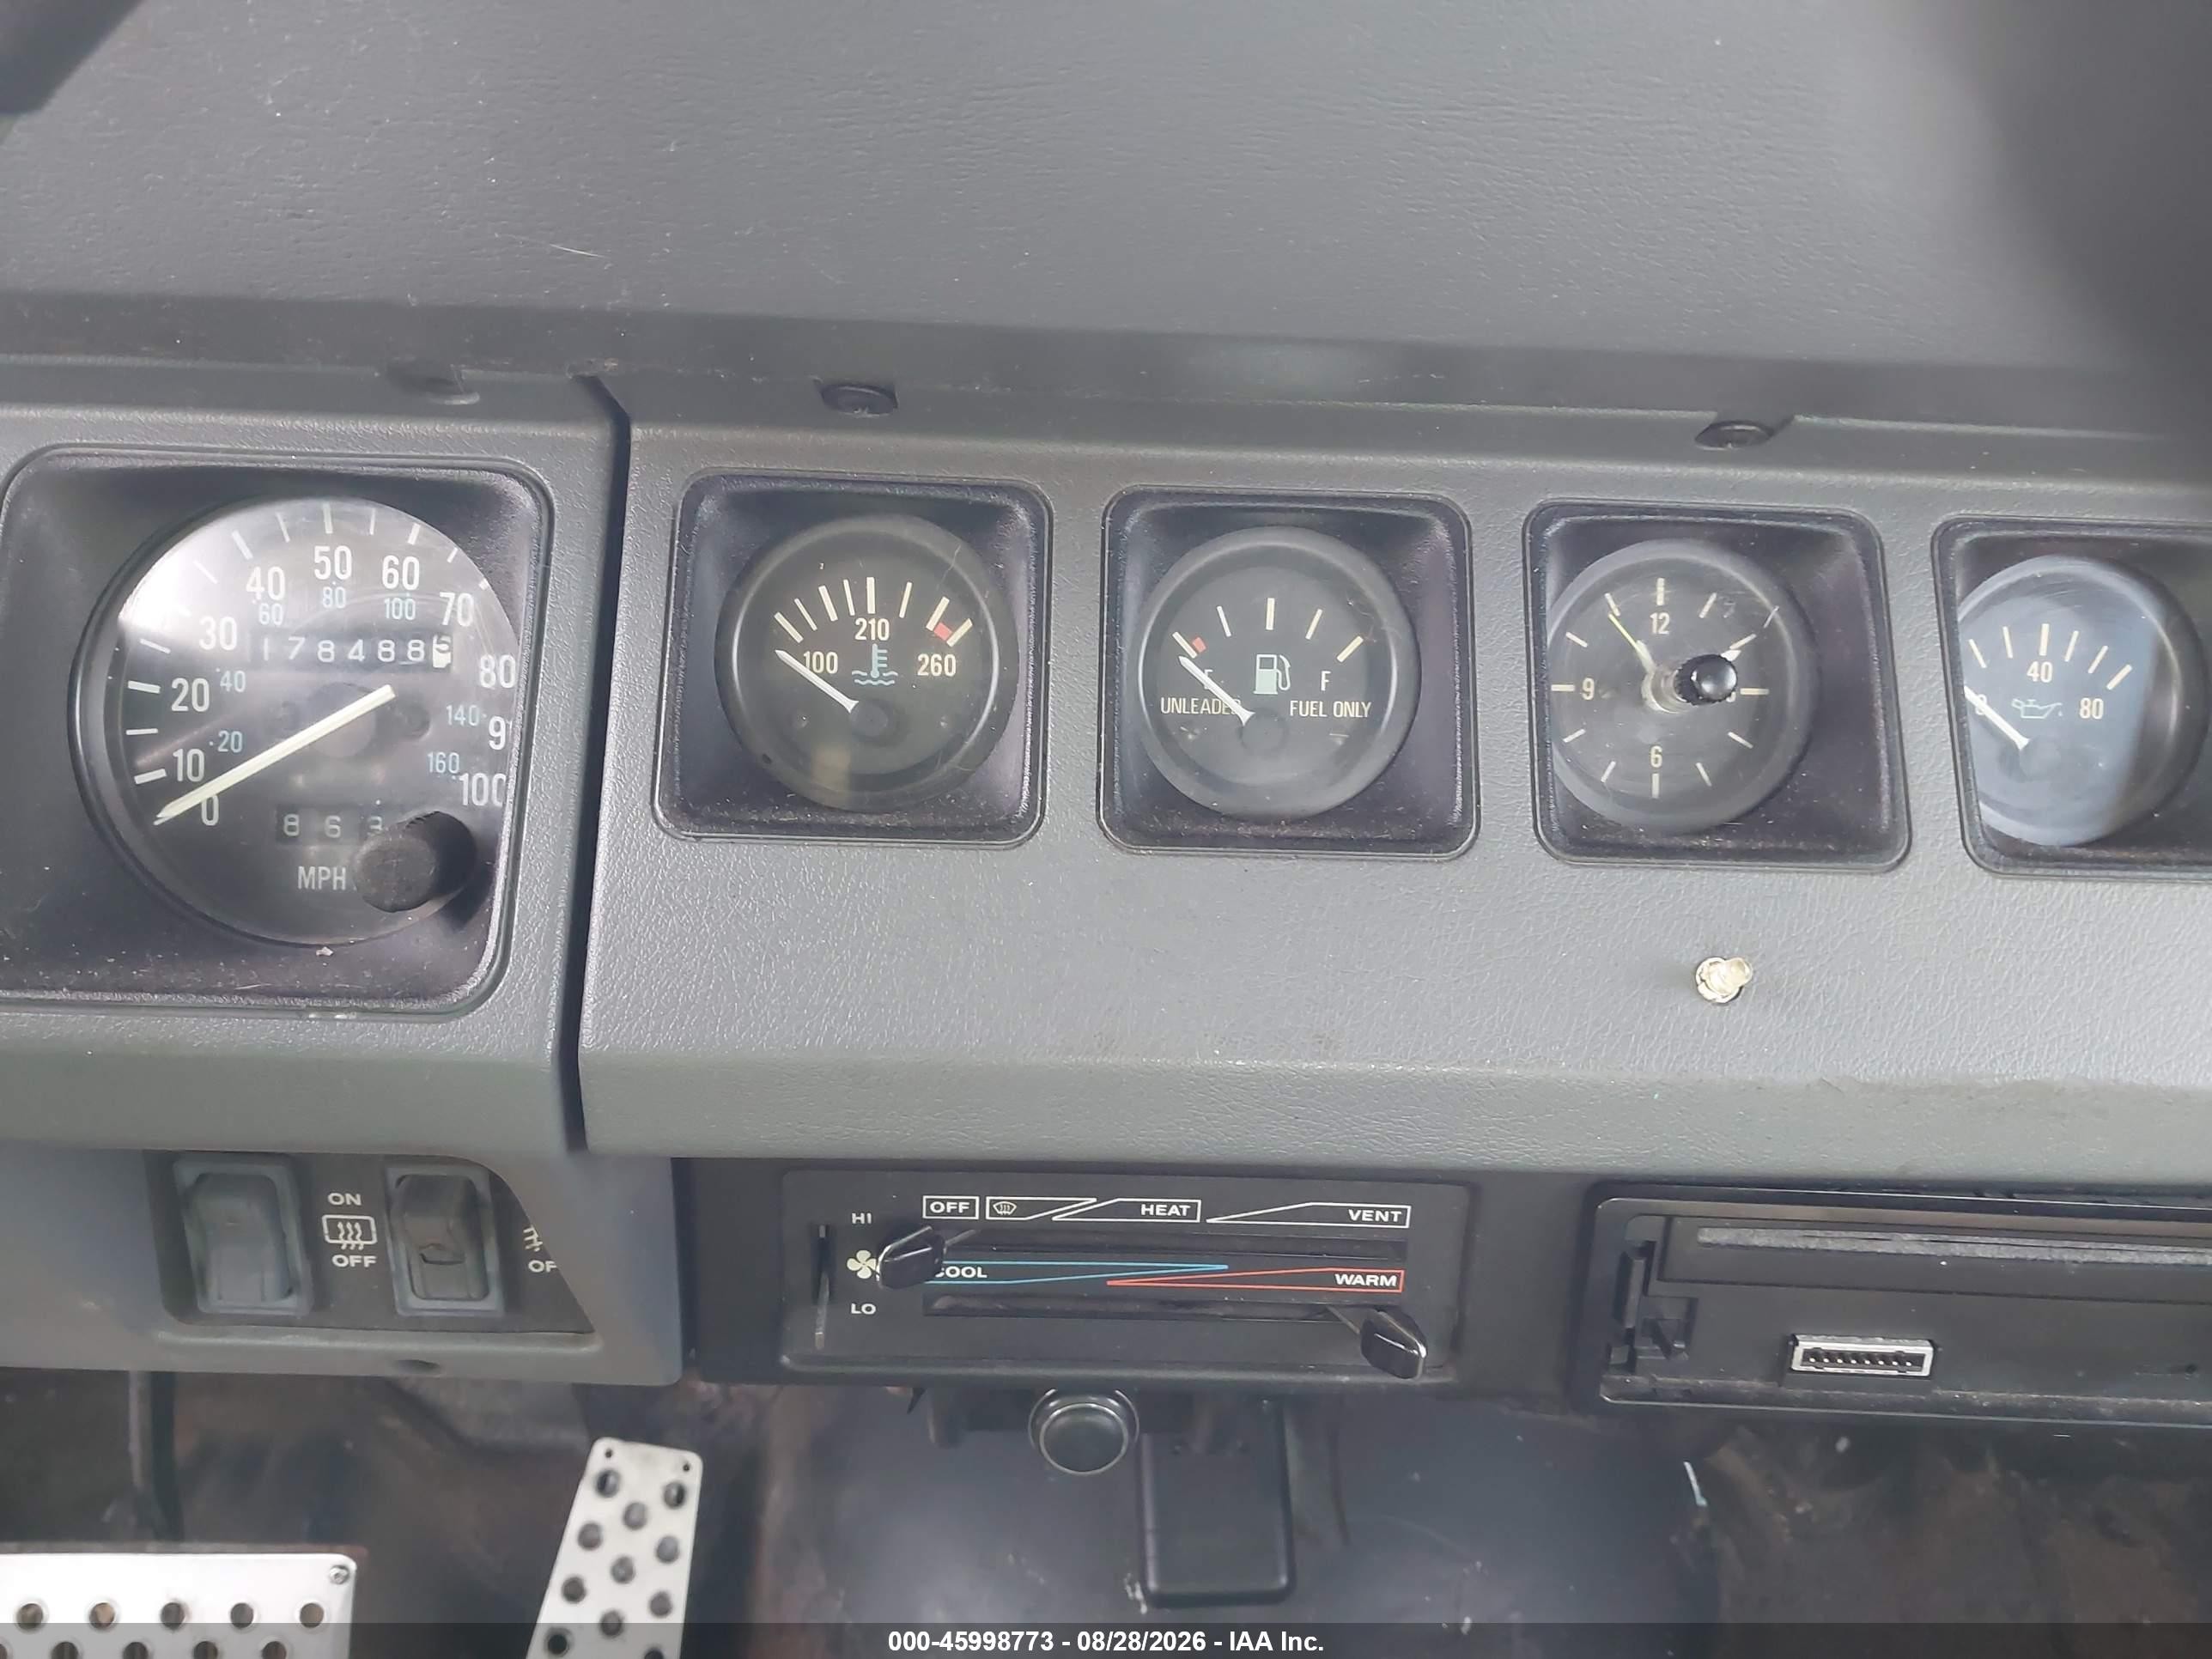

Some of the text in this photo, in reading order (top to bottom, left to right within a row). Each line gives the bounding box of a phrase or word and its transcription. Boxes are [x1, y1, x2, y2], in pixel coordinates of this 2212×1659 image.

[313, 545, 352, 580] 50
[381, 555, 420, 591] 60
[246, 565, 286, 601] 40
[322, 586, 347, 610] 80
[384, 597, 416, 621] 100
[439, 591, 475, 628] 70
[258, 602, 284, 626] 60
[1650, 612, 1670, 635] 12
[198, 615, 238, 651] 30
[854, 617, 890, 641] 210
[479, 653, 517, 690] 80
[803, 650, 839, 674] 100
[916, 653, 957, 678] 260
[2027, 660, 2053, 683] 40
[220, 670, 246, 693] 40
[1320, 671, 1331, 691] F
[1582, 678, 1595, 701] 9
[171, 677, 210, 713] 20
[446, 704, 481, 727] 140
[1289, 700, 1328, 718] FUEL
[1333, 701, 1372, 718] ONLY
[2079, 697, 2104, 720] 80
[217, 730, 244, 754] 20
[173, 748, 205, 783] 10
[427, 750, 460, 775] 160
[1650, 745, 1662, 768] 6
[201, 794, 220, 826] 0
[297, 866, 347, 890] MPH
[327, 1192, 362, 1206] ON
[929, 1201, 970, 1214] OFF
[1140, 1203, 1191, 1218] HEAT
[851, 1212, 872, 1224] HI
[1347, 1209, 1402, 1223] VENT
[331, 1254, 377, 1268] OFF
[1334, 1273, 1398, 1287] WARM
[850, 1303, 877, 1316] LO
